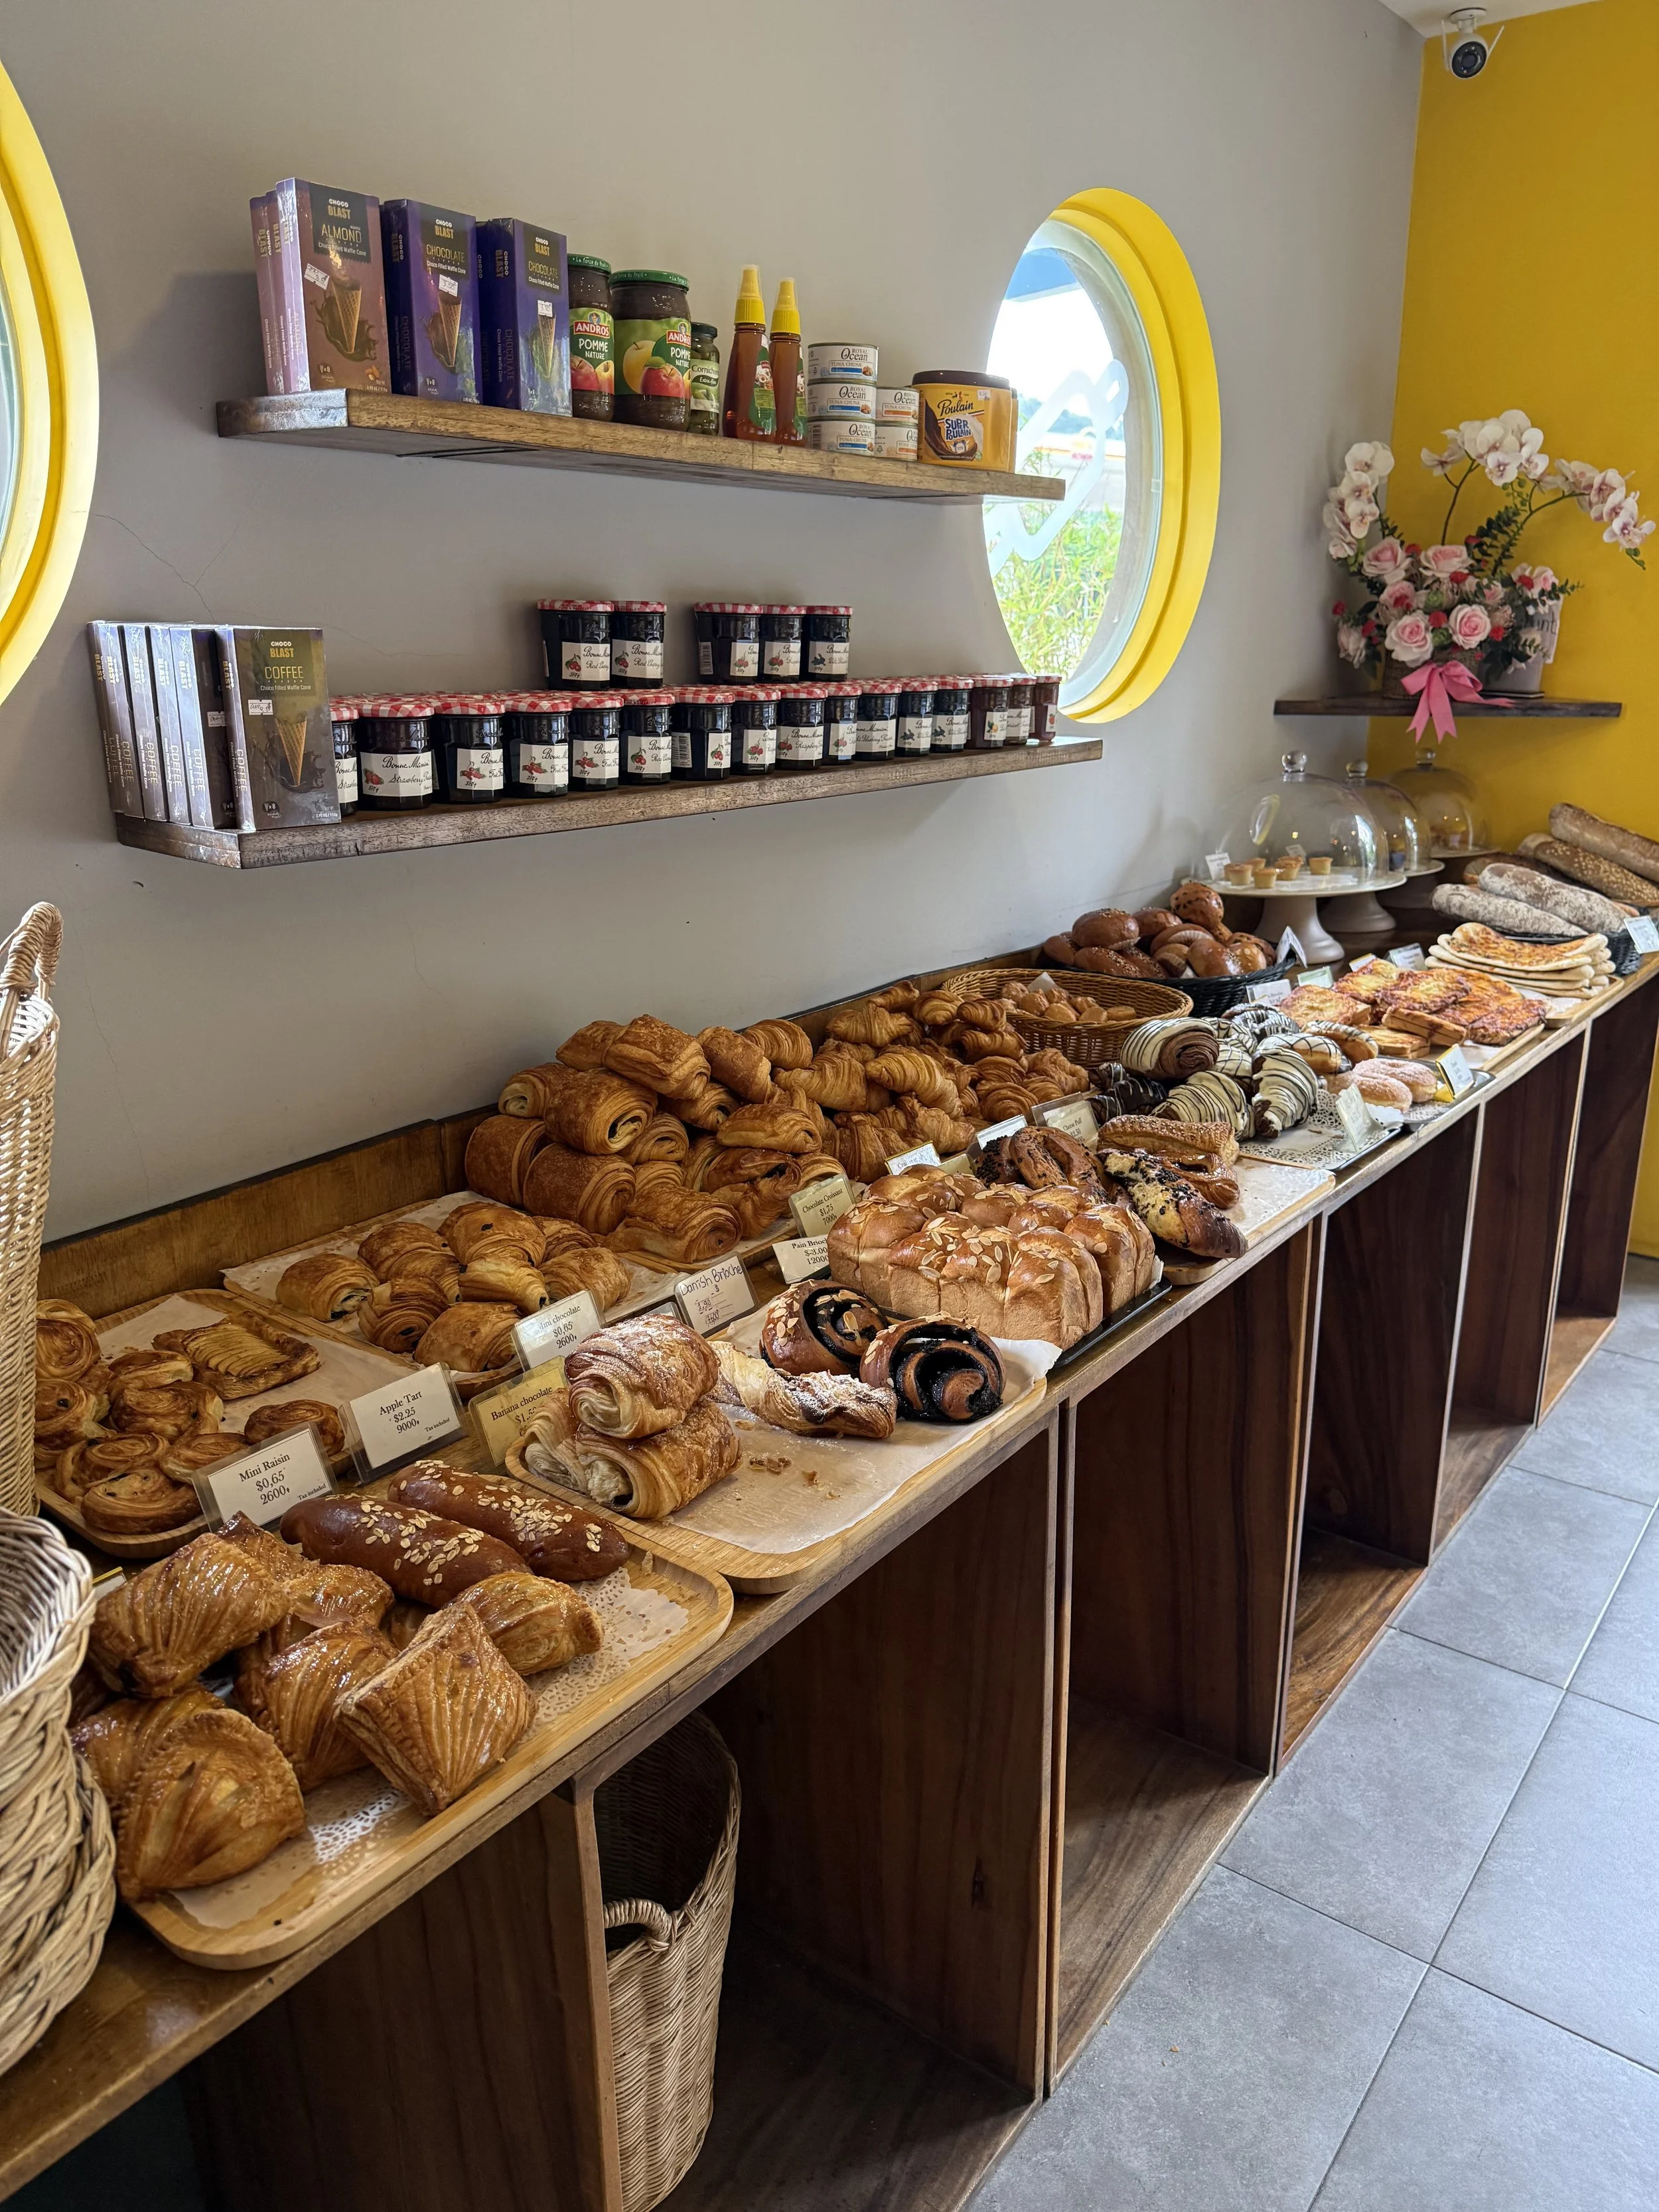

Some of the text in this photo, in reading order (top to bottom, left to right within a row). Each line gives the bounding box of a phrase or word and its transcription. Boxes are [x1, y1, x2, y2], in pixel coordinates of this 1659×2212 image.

[328, 198, 349, 208] CHOCO
[327, 205, 351, 220] BLAST
[435, 218, 452, 228] CHOCO
[273, 223, 281, 253] BLAST
[322, 224, 362, 244] ALMOND
[435, 225, 454, 239] BLAST
[258, 228, 268, 258] BLAST
[536, 237, 548, 246] CHOCO
[427, 244, 465, 263] CHOCOLATE
[535, 243, 549, 256] BLAST
[528, 261, 559, 279] CHOCOLATE
[575, 323, 609, 336] ANDROS
[579, 338, 608, 352] POMME
[585, 350, 605, 360] NATURE
[670, 347, 691, 360] POMME
[841, 348, 868, 361] Ocean
[676, 359, 689, 368] NATURE
[839, 386, 866, 400] Ocean
[895, 392, 916, 405] Ocean
[937, 399, 974, 417] Poulain
[849, 423, 872, 437] Ocean
[945, 418, 970, 430] SUPER
[946, 429, 972, 441] POULAIN
[270, 648, 294, 658] BLAST
[583, 646, 601, 657] Bonne
[632, 644, 650, 655] Bonne
[107, 656, 116, 684] BLAST
[179, 661, 188, 690] BLAST
[223, 661, 232, 690] BLAST
[265, 666, 304, 679] COFFEE
[593, 743, 612, 755] Bonne
[648, 739, 665, 751] Bonne
[480, 751, 498, 764] Bonne
[542, 747, 561, 759] Bonne
[122, 741, 134, 782] COFFEE
[147, 742, 158, 784] COFFEE
[171, 745, 182, 786] COFFEE
[382, 755, 408, 769] Bonne
[193, 749, 205, 791] COFFEE
[237, 749, 248, 792] COFFEE
[388, 772, 423, 786] Strawberry
[802, 1189, 843, 1213] Chocolate Croissant
[820, 1203, 834, 1217] $1,75
[680, 1264, 743, 1295] Danish Brioche
[552, 1305, 581, 1323] chocolate
[553, 1321, 573, 1338] $0,65
[380, 1391, 422, 1415] Apple Tart
[491, 1386, 553, 1421] Banana chocolate
[394, 1406, 415, 1423] $2.25
[433, 1417, 451, 1429] included
[239, 1454, 290, 1482] Mini Raisin
[255, 1470, 285, 1492] $0,65
[307, 1483, 326, 1497] included
